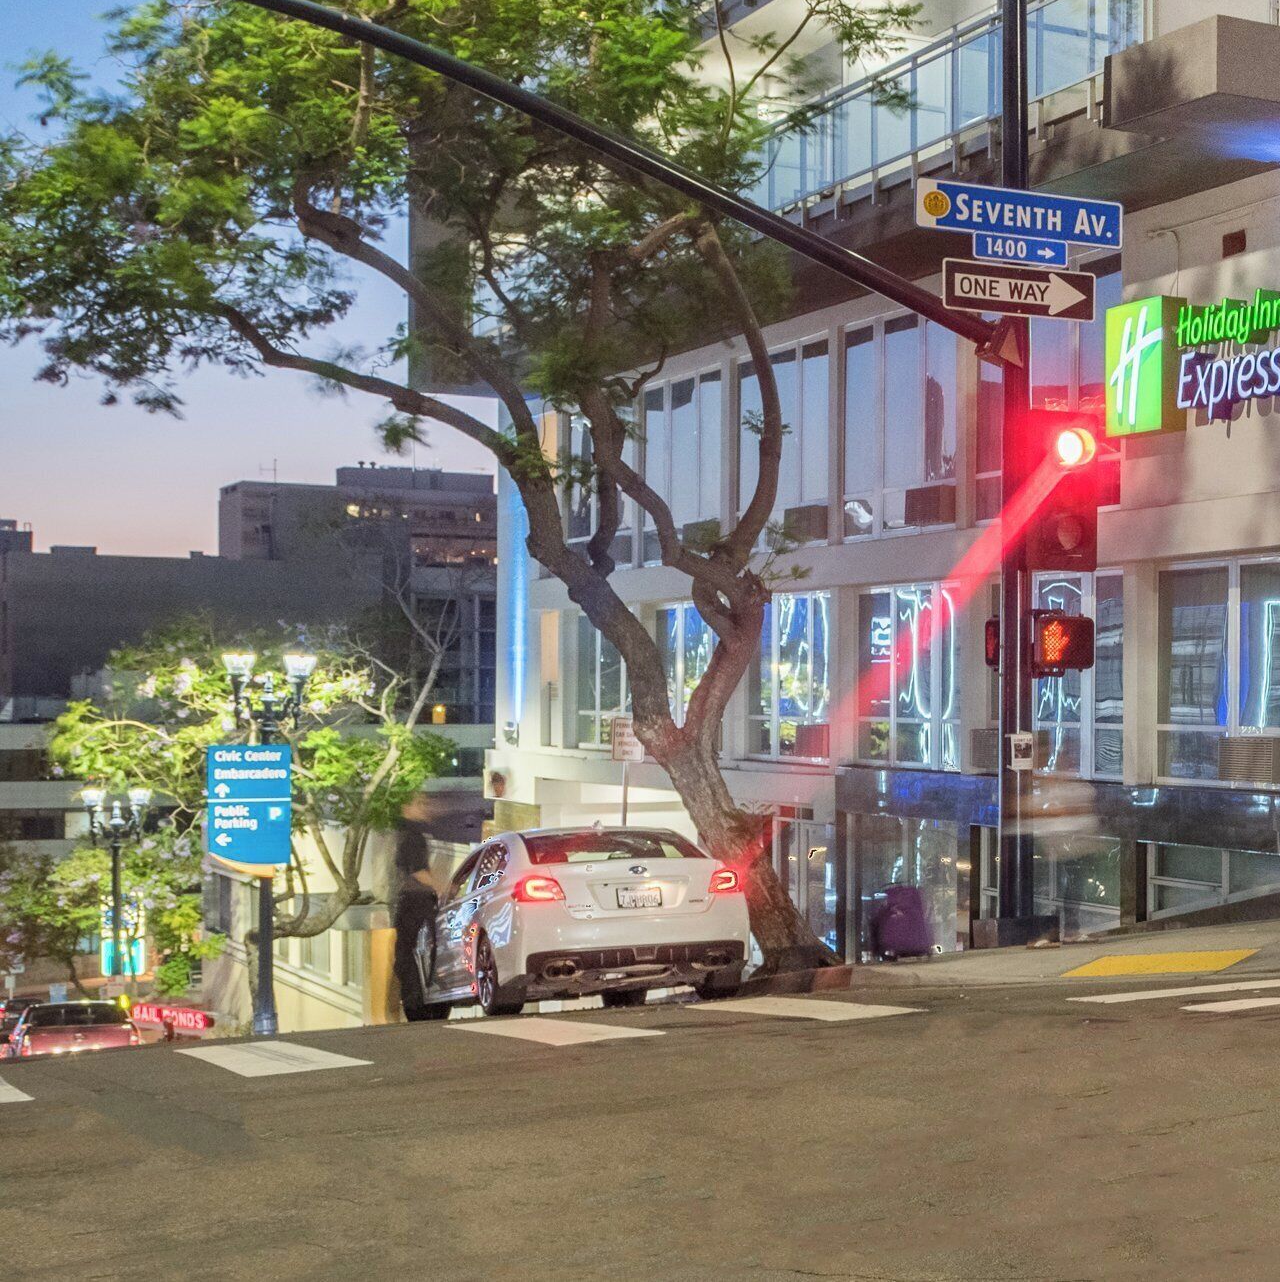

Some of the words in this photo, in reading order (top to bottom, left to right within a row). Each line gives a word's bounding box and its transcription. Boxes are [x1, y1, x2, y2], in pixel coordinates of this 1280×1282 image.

[956, 193, 1062, 232] SEVENTH
[1073, 208, 1112, 238] AV.
[986, 237, 1027, 258] 1400
[960, 276, 1000, 298] ONE
[1008, 281, 1050, 303] WAY
[1176, 297, 1252, 347] Holiday
[214, 750, 242, 762] Civic
[244, 750, 282, 762] Center
[213, 768, 287, 780] Embarcadero
[214, 805, 250, 817] Public
[214, 817, 258, 831] Parking
[134, 1006, 161, 1023] BAIL
